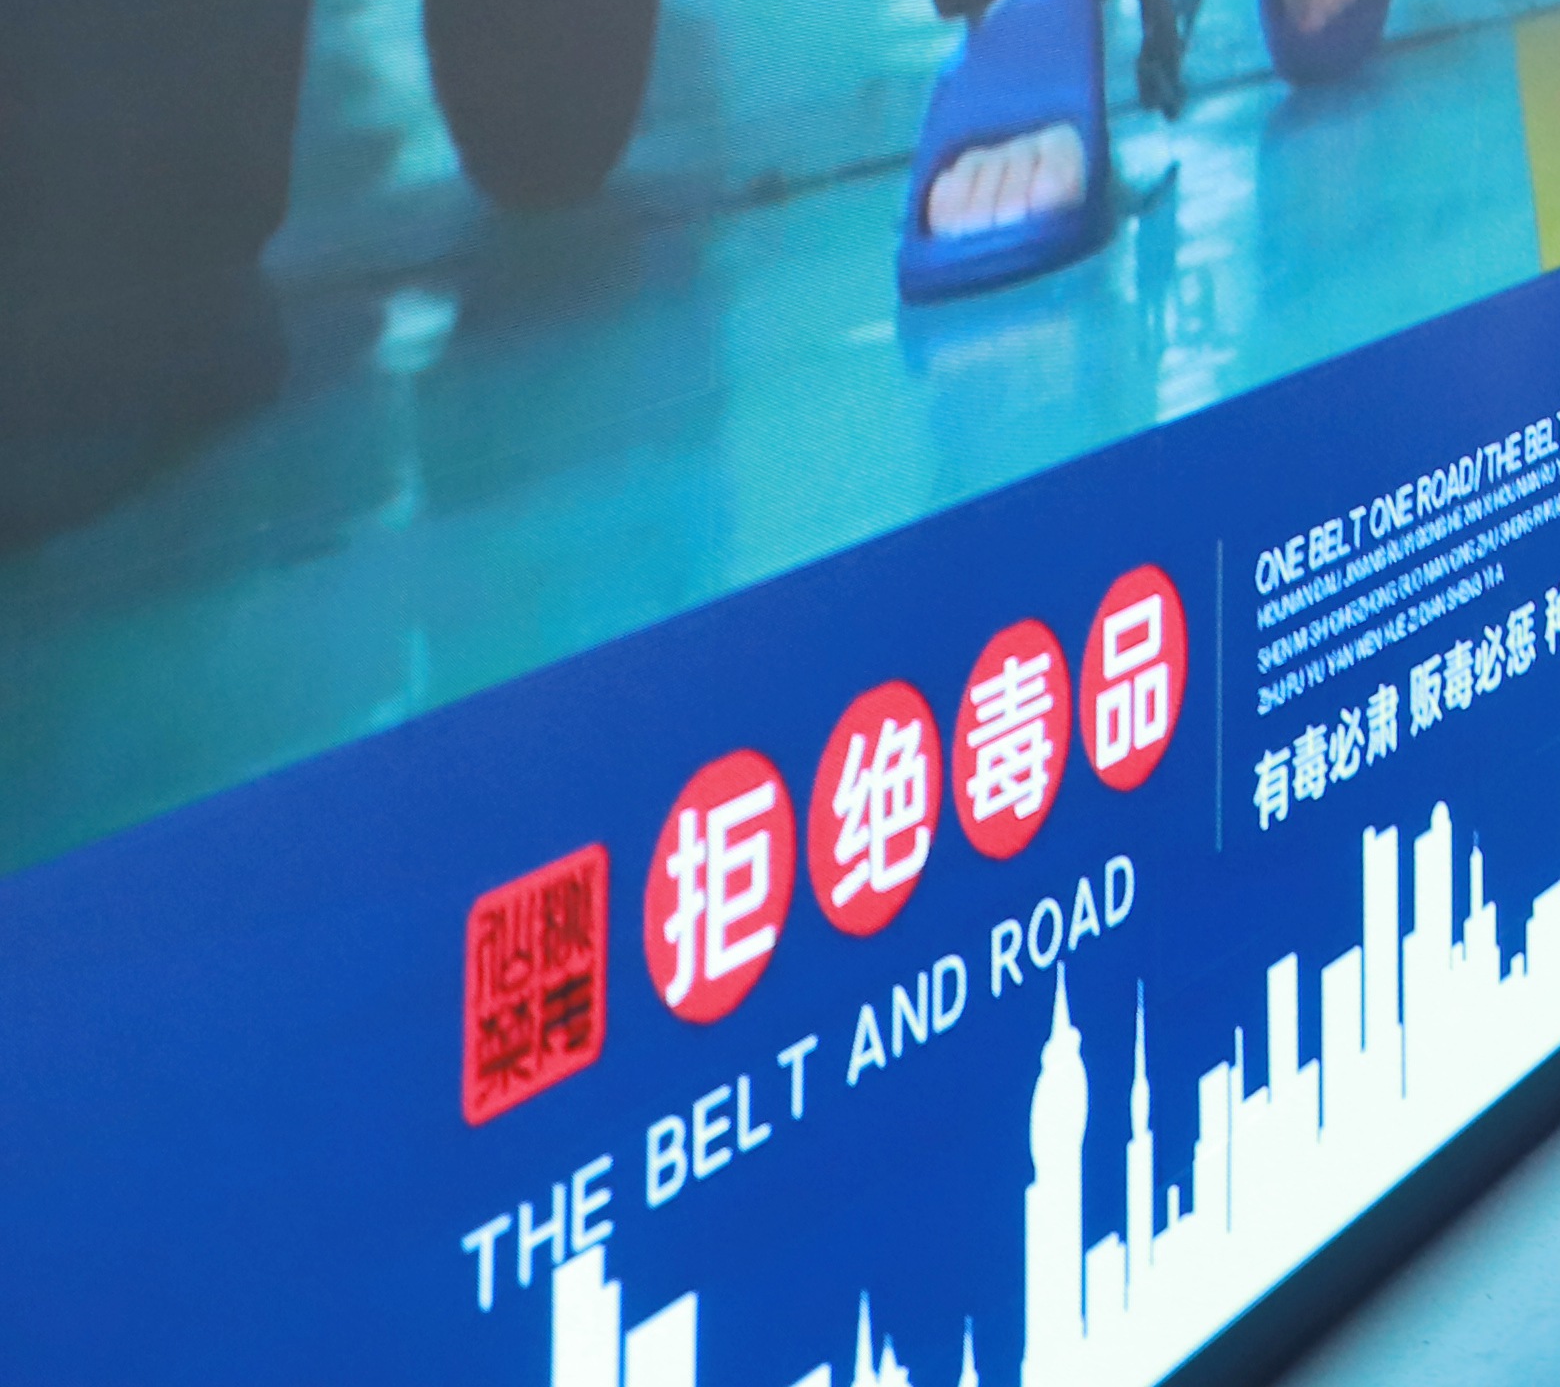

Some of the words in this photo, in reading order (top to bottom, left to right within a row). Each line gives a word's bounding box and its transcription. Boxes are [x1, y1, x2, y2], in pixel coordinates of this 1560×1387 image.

[1254, 535, 1306, 595] ONE
[1308, 505, 1367, 571] BELT
[1369, 483, 1414, 540] ONE
[664, 593, 1170, 1009] 拒绝毒品
[1253, 682, 1399, 831] 有毒必肃
[1409, 601, 1537, 737] 贩毒必惩
[461, 1154, 615, 1312] THE
[646, 1035, 819, 1210] BELT
[847, 953, 968, 1087] AND
[989, 854, 1136, 999] ROAD
